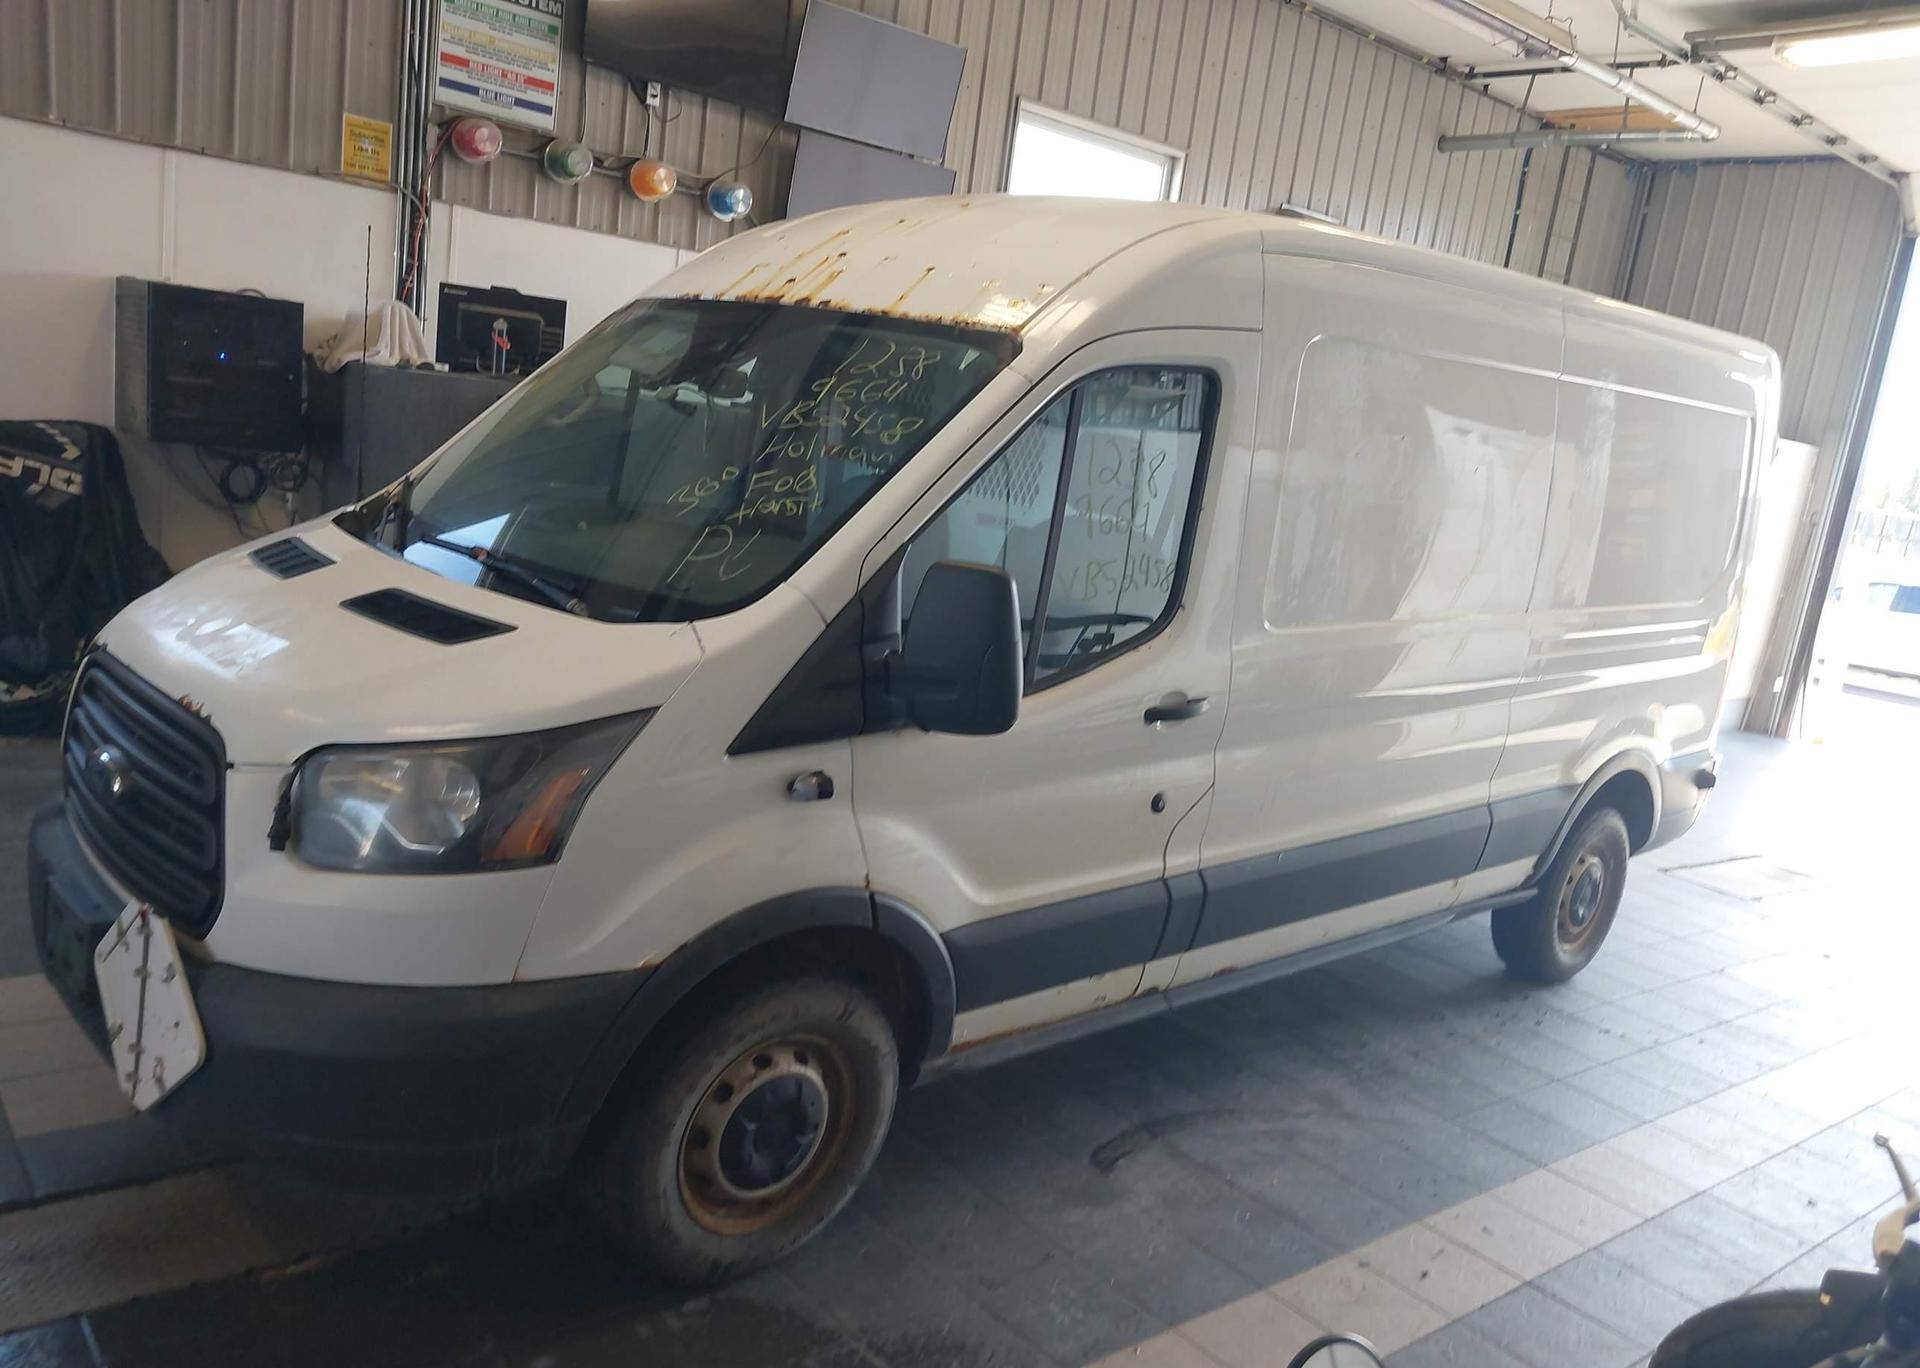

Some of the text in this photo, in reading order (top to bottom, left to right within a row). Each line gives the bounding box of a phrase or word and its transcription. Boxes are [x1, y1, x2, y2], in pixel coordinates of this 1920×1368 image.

[478, 87, 495, 99] BLUE
[496, 91, 515, 105] LIGHT
[834, 337, 940, 380] 1258
[811, 374, 909, 404] 9664
